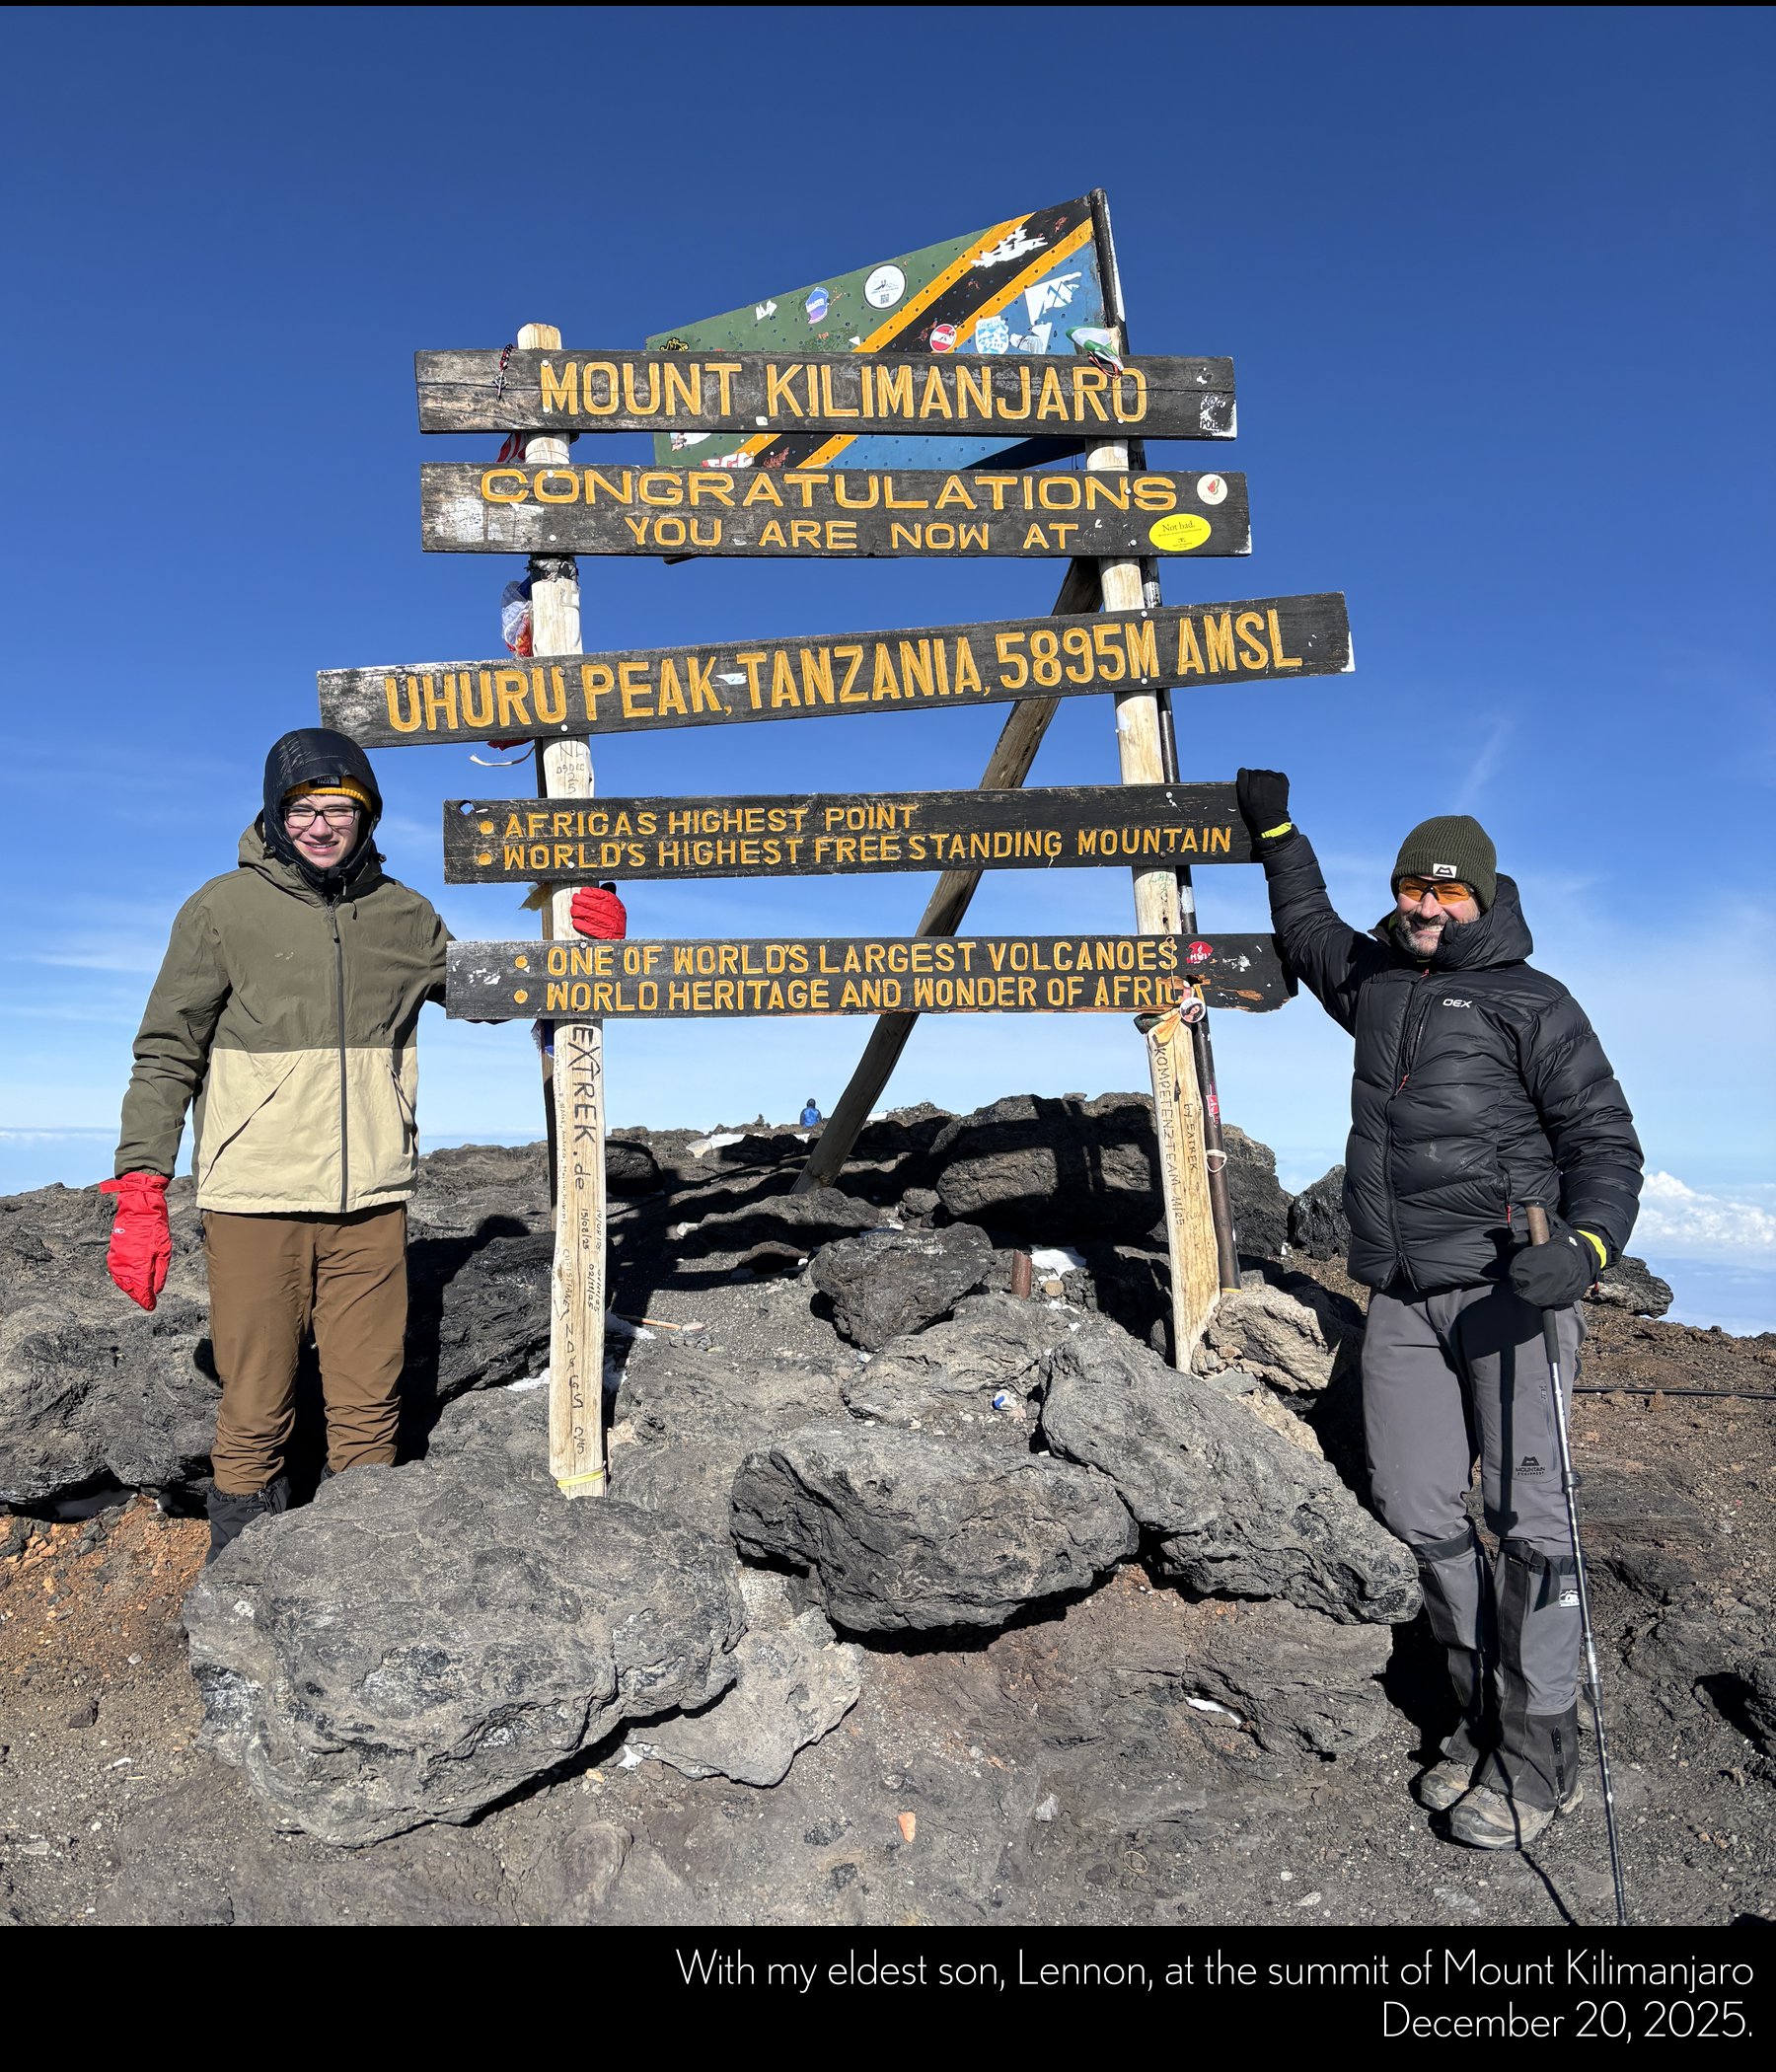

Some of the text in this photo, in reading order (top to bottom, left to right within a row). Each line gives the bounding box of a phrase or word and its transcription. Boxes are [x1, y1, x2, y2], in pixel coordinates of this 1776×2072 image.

[540, 362, 1147, 421] MOUNT KILIMANJARO
[480, 468, 1177, 512] CONGRATULATIONS
[626, 517, 1078, 553] YOU ARE NOW AT
[1162, 522, 1178, 533] Not
[1178, 519, 1196, 530] bad.
[383, 608, 1303, 732] UHURU PEAK, TANZANIA, 5895M AMSL
[668, 808, 809, 835] HIGHEST
[825, 804, 918, 831] POINT
[503, 826, 1231, 870] WORLD'S HIGHEST FREE STANDING MOUNTAIN
[547, 941, 1177, 977] ONE OF WORLD'S LARGEST VOLCANOES
[546, 981, 658, 1012] WORLD
[668, 980, 830, 1011] HERITAGE
[840, 979, 902, 1008] AND
[914, 977, 1036, 1007] WONDER
[1047, 976, 1083, 1006] OF
[1443, 998, 1472, 1009] OEX
[1154, 1048, 1183, 1187] KOMPETENZTEAM
[1183, 1103, 1194, 1118] by
